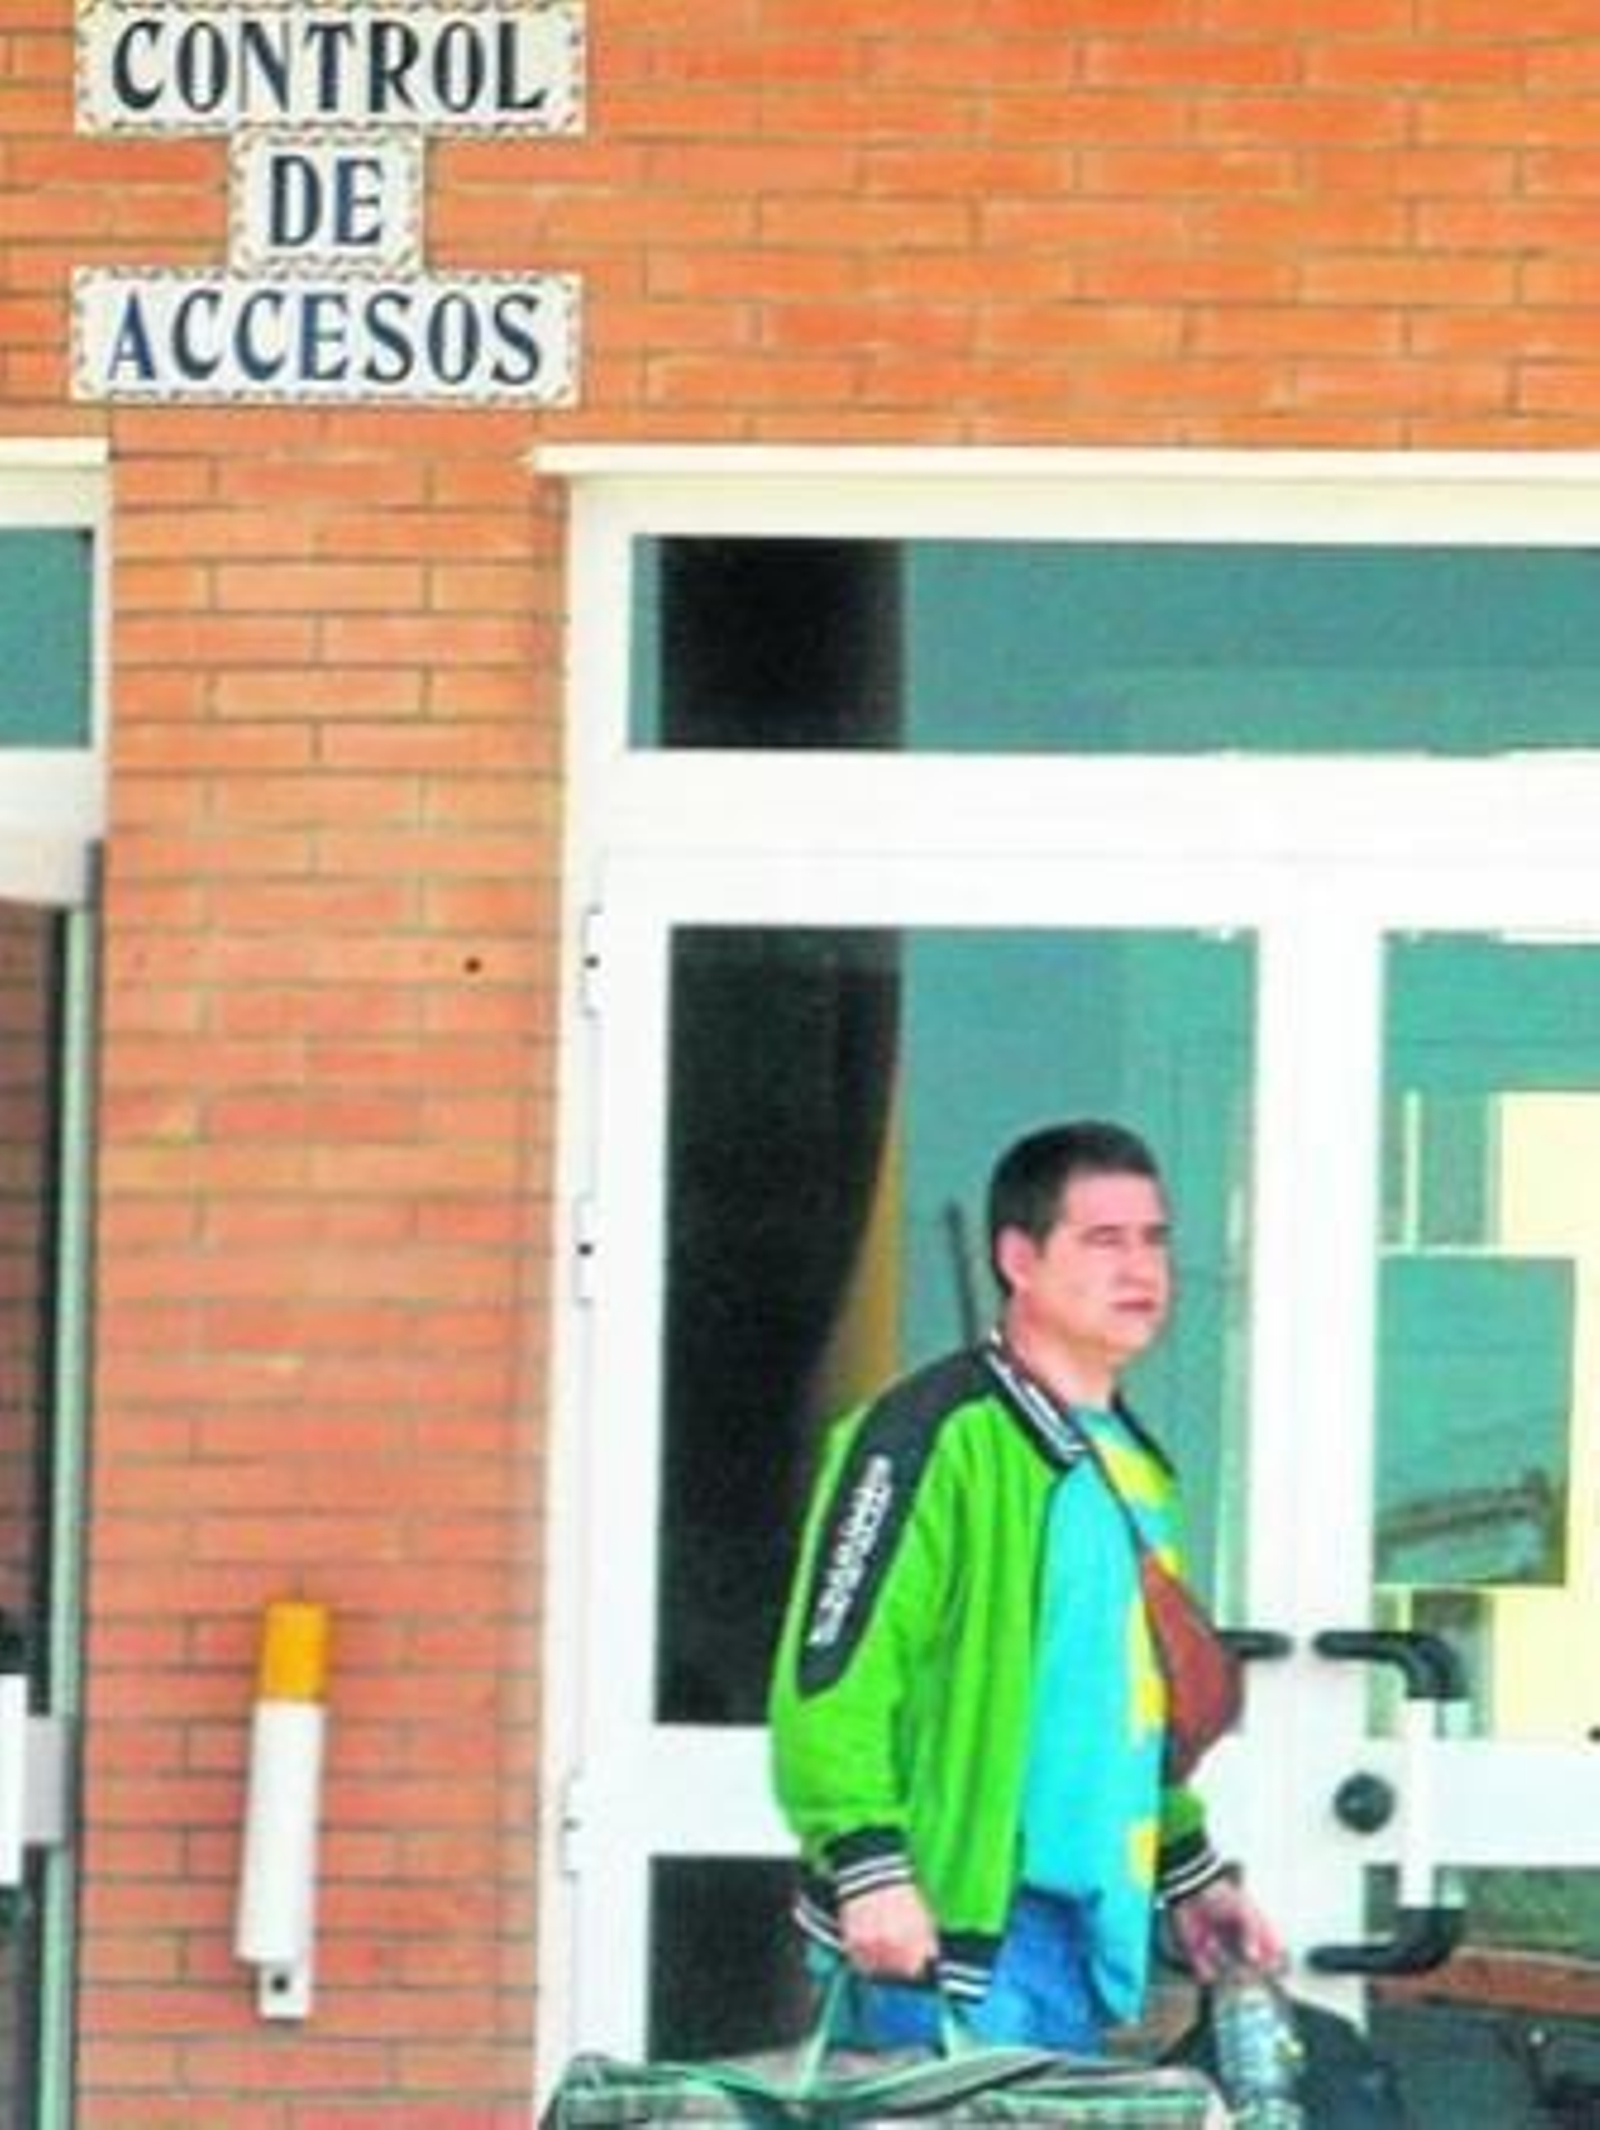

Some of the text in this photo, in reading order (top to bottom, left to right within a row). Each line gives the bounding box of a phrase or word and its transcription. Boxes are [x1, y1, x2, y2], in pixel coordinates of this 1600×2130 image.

[113, 20, 547, 112] CONTROL
[270, 155, 384, 246] DE
[107, 289, 541, 384] ACCESOS
